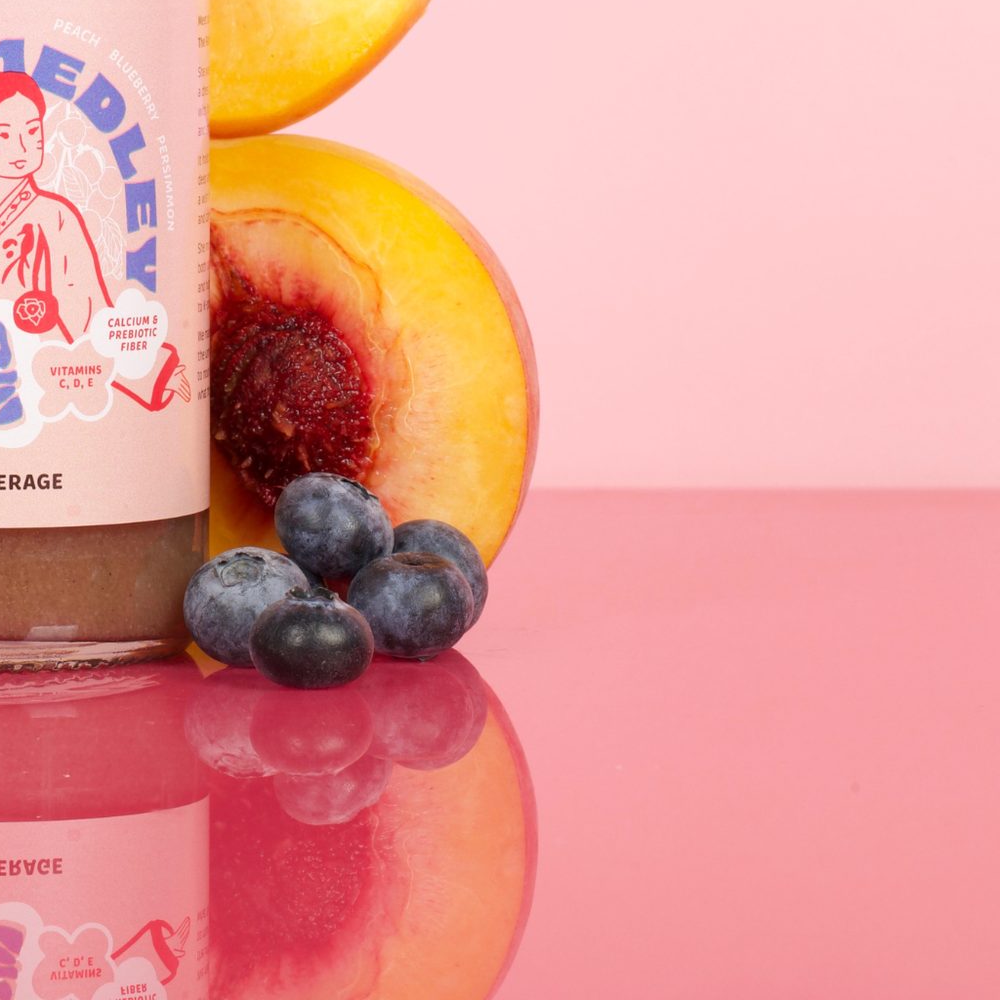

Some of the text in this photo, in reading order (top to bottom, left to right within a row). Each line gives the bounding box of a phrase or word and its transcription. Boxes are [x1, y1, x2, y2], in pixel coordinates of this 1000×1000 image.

[53, 18, 175, 232] PEACH BLUEBERRY PERSIMMON
[107, 315, 159, 328] CALCIUM &
[108, 327, 158, 341] PREBIOTIC
[120, 341, 148, 352] FIBER
[50, 365, 102, 376] VITAMINS
[59, 378, 94, 390] C, D, E
